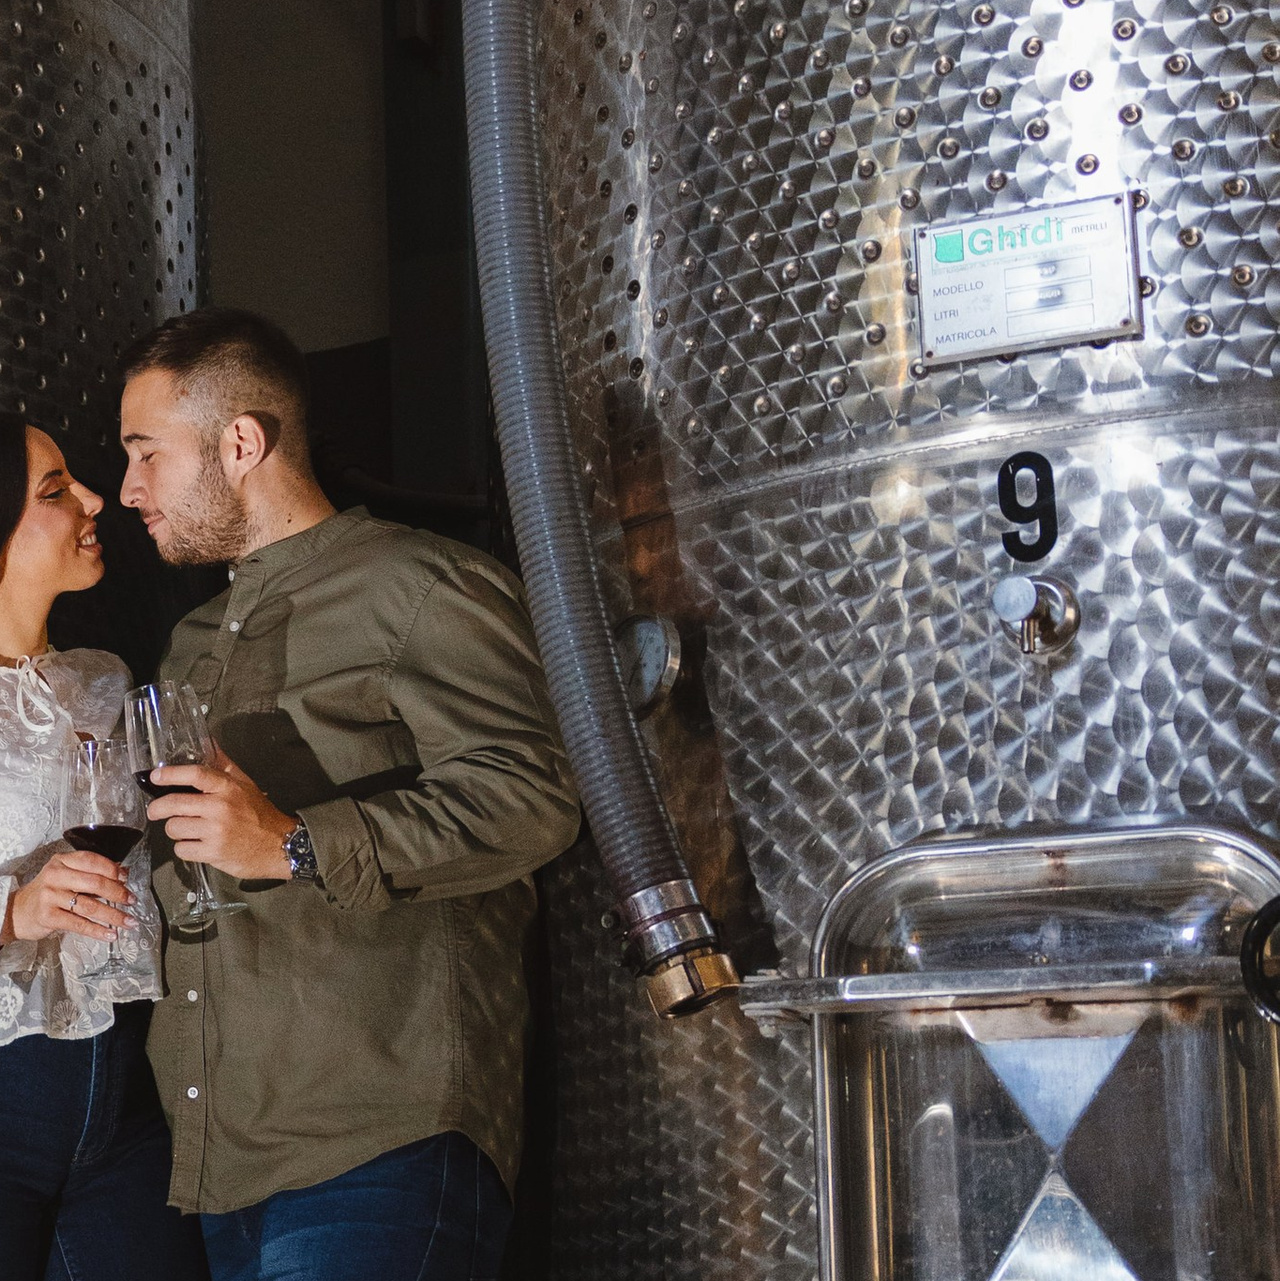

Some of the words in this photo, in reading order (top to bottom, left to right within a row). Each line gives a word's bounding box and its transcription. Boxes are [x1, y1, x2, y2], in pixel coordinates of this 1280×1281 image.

[968, 216, 1064, 256] Ghidi
[933, 281, 984, 297] MODELLO
[934, 309, 959, 321] LITRI
[935, 326, 997, 345] MATRICOLA
[998, 451, 1058, 562] 9
